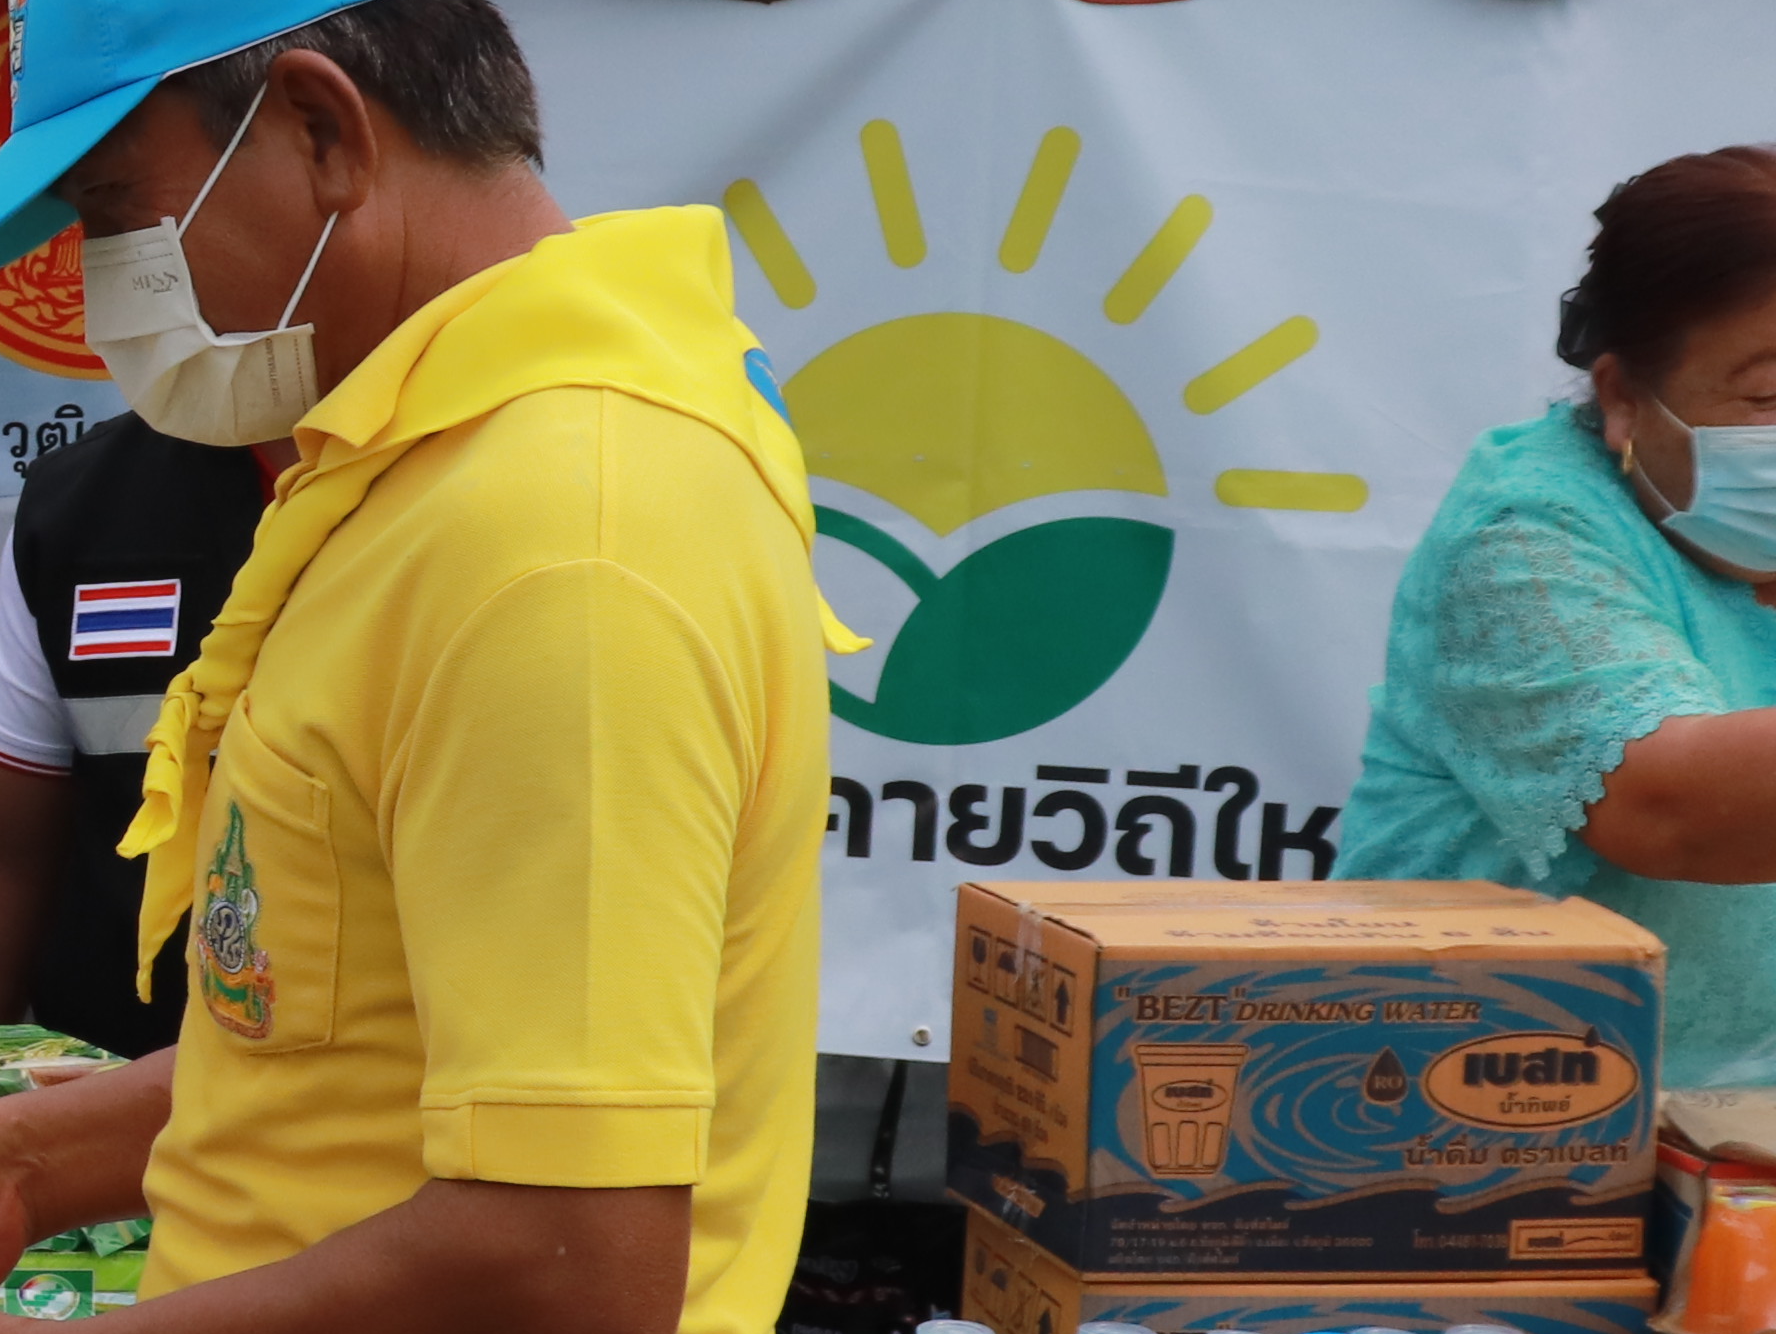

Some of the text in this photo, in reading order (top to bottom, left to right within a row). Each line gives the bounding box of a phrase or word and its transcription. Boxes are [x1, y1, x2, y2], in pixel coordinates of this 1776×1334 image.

[1234, 1001, 1374, 1022] DRINKING
[1383, 1001, 1480, 1022] WATER
[1373, 1075, 1404, 1090] RO
[1405, 1134, 1631, 1166] น้ำดื่ม ตราเบสท์
